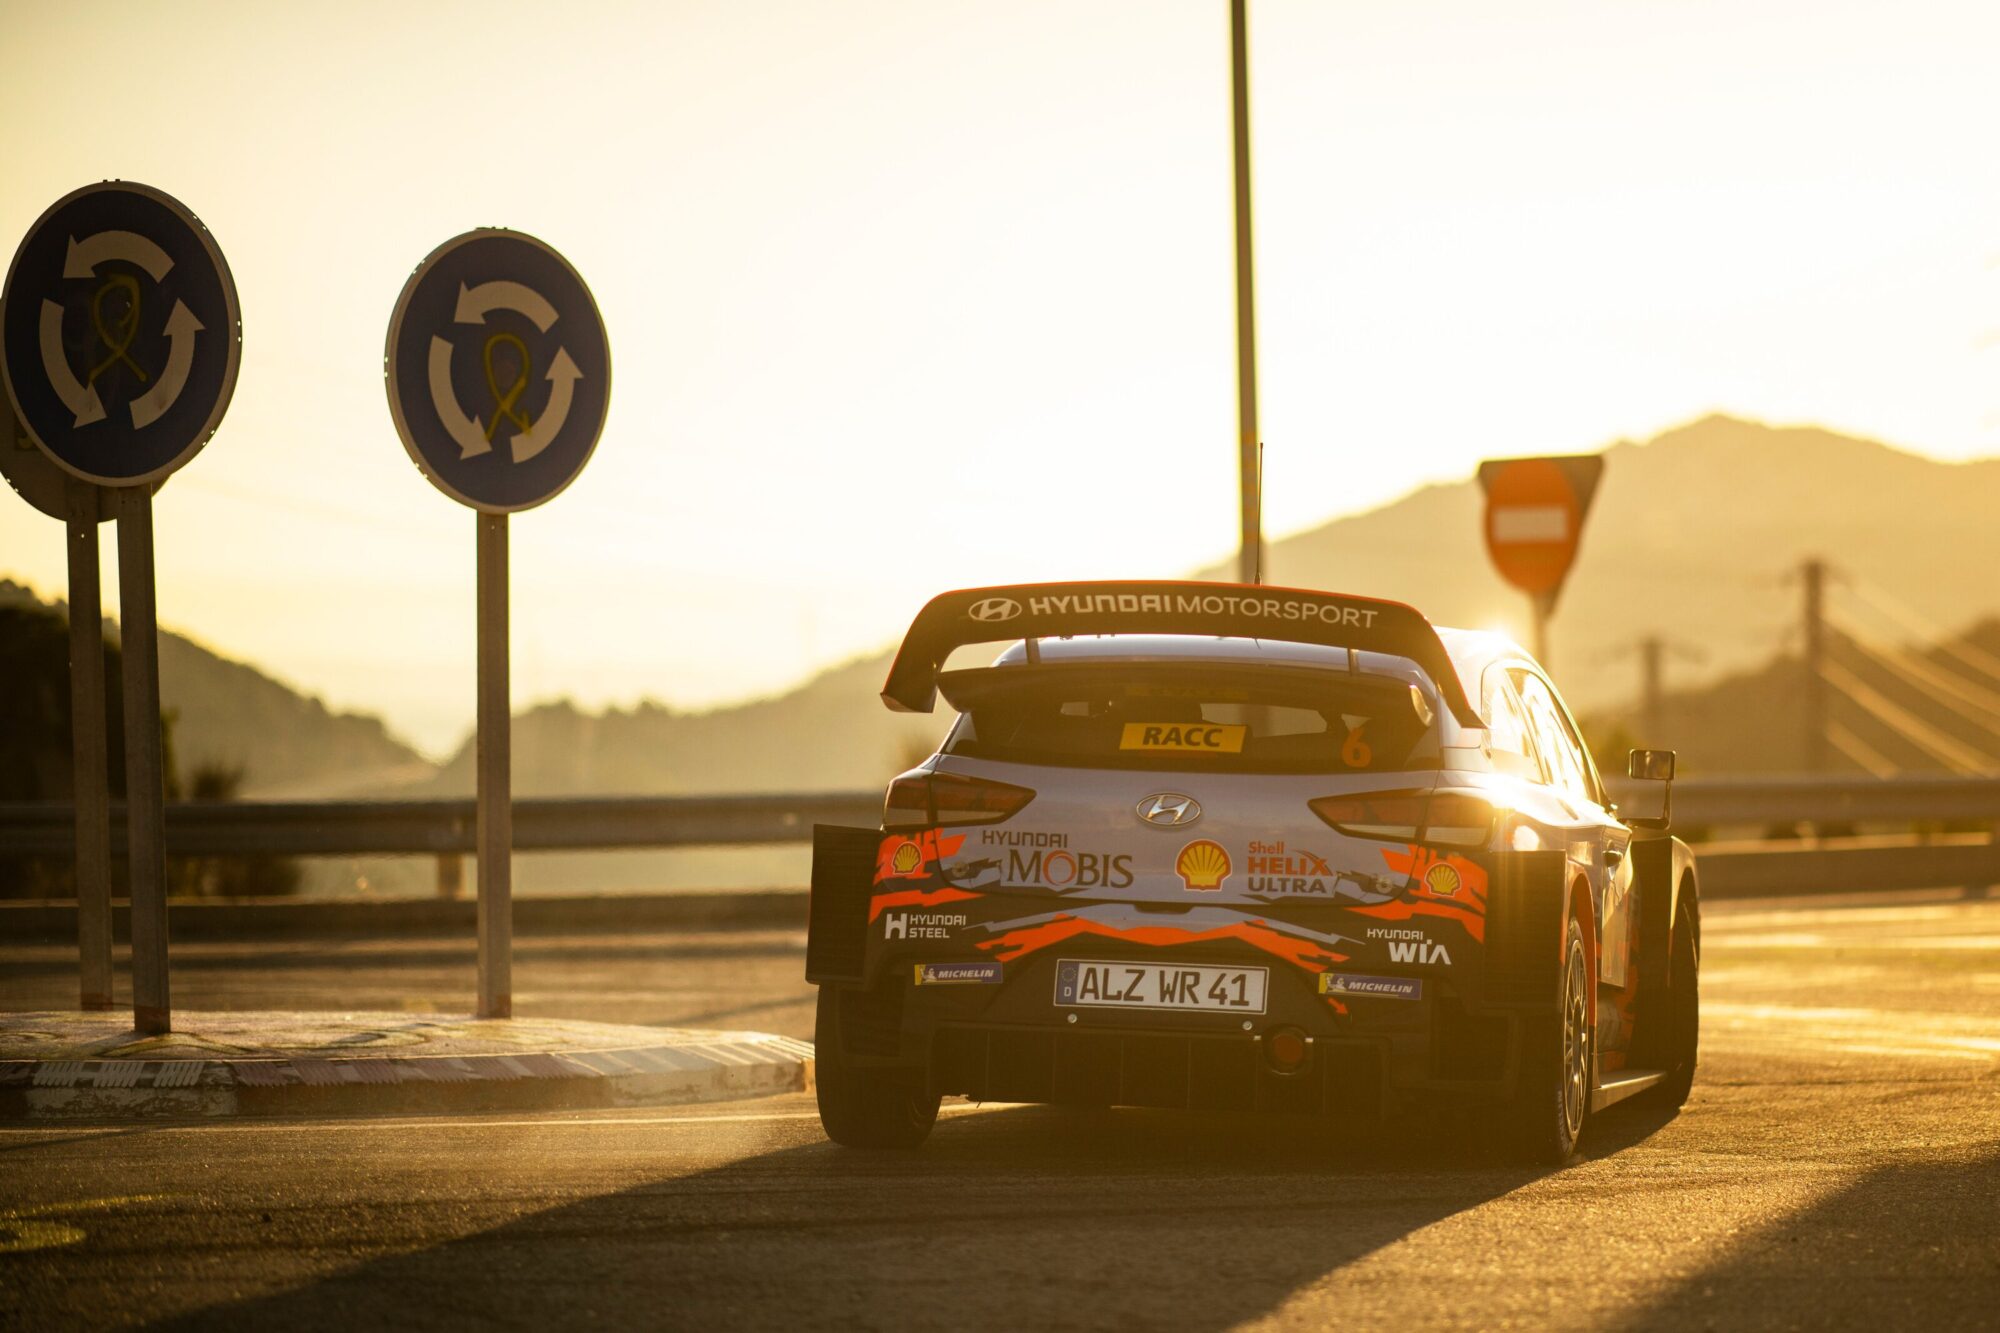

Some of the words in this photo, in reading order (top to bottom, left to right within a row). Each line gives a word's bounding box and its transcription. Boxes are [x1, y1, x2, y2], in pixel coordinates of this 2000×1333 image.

[1029, 594, 1172, 616] HYUNDAI
[1177, 596, 1379, 629] MOTORSPORT
[1142, 726, 1223, 748] RACC
[1342, 728, 1372, 768] 6
[982, 830, 1068, 848] HYUNDAI
[1248, 841, 1285, 854] Shell
[1007, 849, 1134, 889] MOBIS
[1247, 851, 1333, 876] HELIX
[1248, 877, 1327, 894] ULTRA
[909, 914, 967, 926] HYUNDAI
[909, 927, 950, 939] STEEL
[1366, 928, 1424, 940] HYUNDAI
[937, 969, 995, 979] MICHELIN
[1064, 986, 1072, 997] D
[1079, 966, 1146, 1002] ALZ
[1159, 969, 1201, 1004] WR
[1207, 972, 1250, 1007] 41
[1348, 981, 1414, 993] MICHELIN
